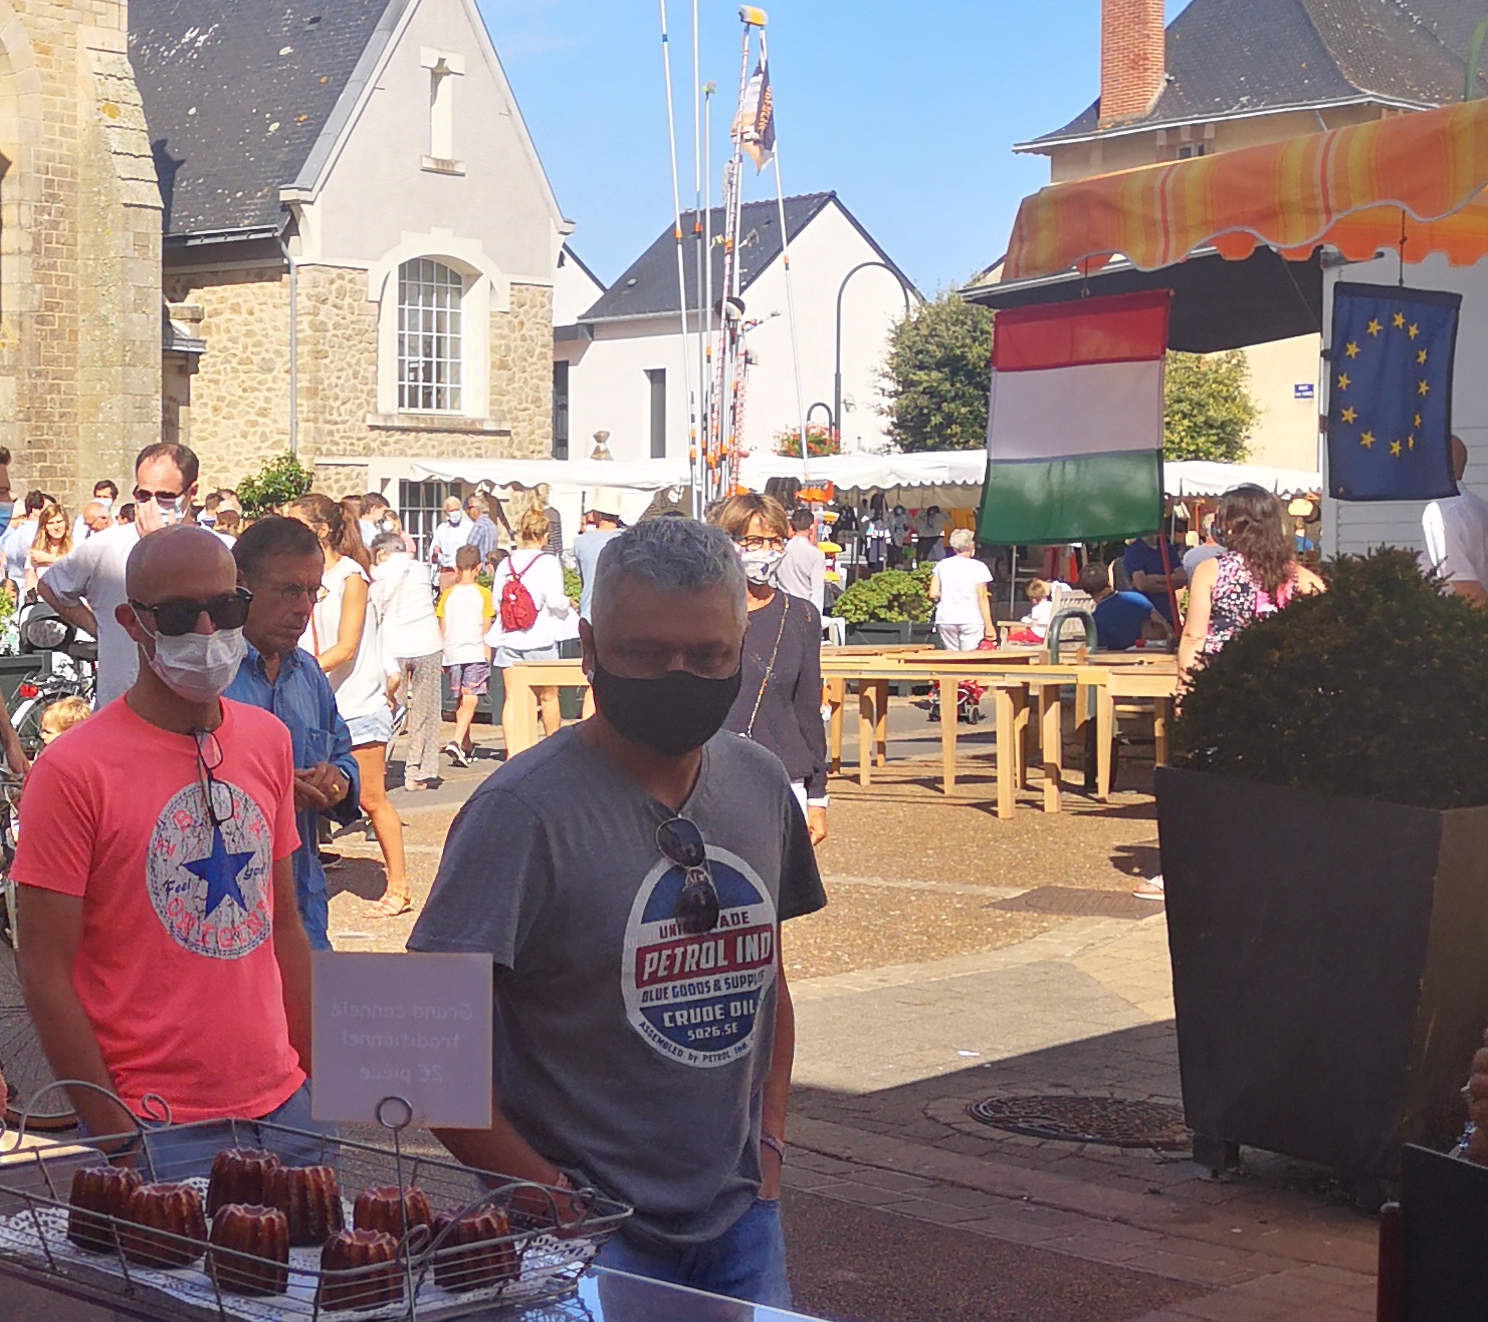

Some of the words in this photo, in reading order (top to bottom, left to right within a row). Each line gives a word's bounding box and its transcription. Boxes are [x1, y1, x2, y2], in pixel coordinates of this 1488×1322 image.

[163, 877, 192, 896] Feel
[718, 910, 751, 929] ADE
[642, 938, 729, 981] PETROL
[671, 980, 712, 999] GOODS
[713, 978, 722, 993] &
[663, 1003, 726, 1028] CRUDE
[729, 999, 756, 1018] OIL
[638, 1021, 683, 1058] ASSEMBLED
[702, 1050, 732, 1063] PETROL
